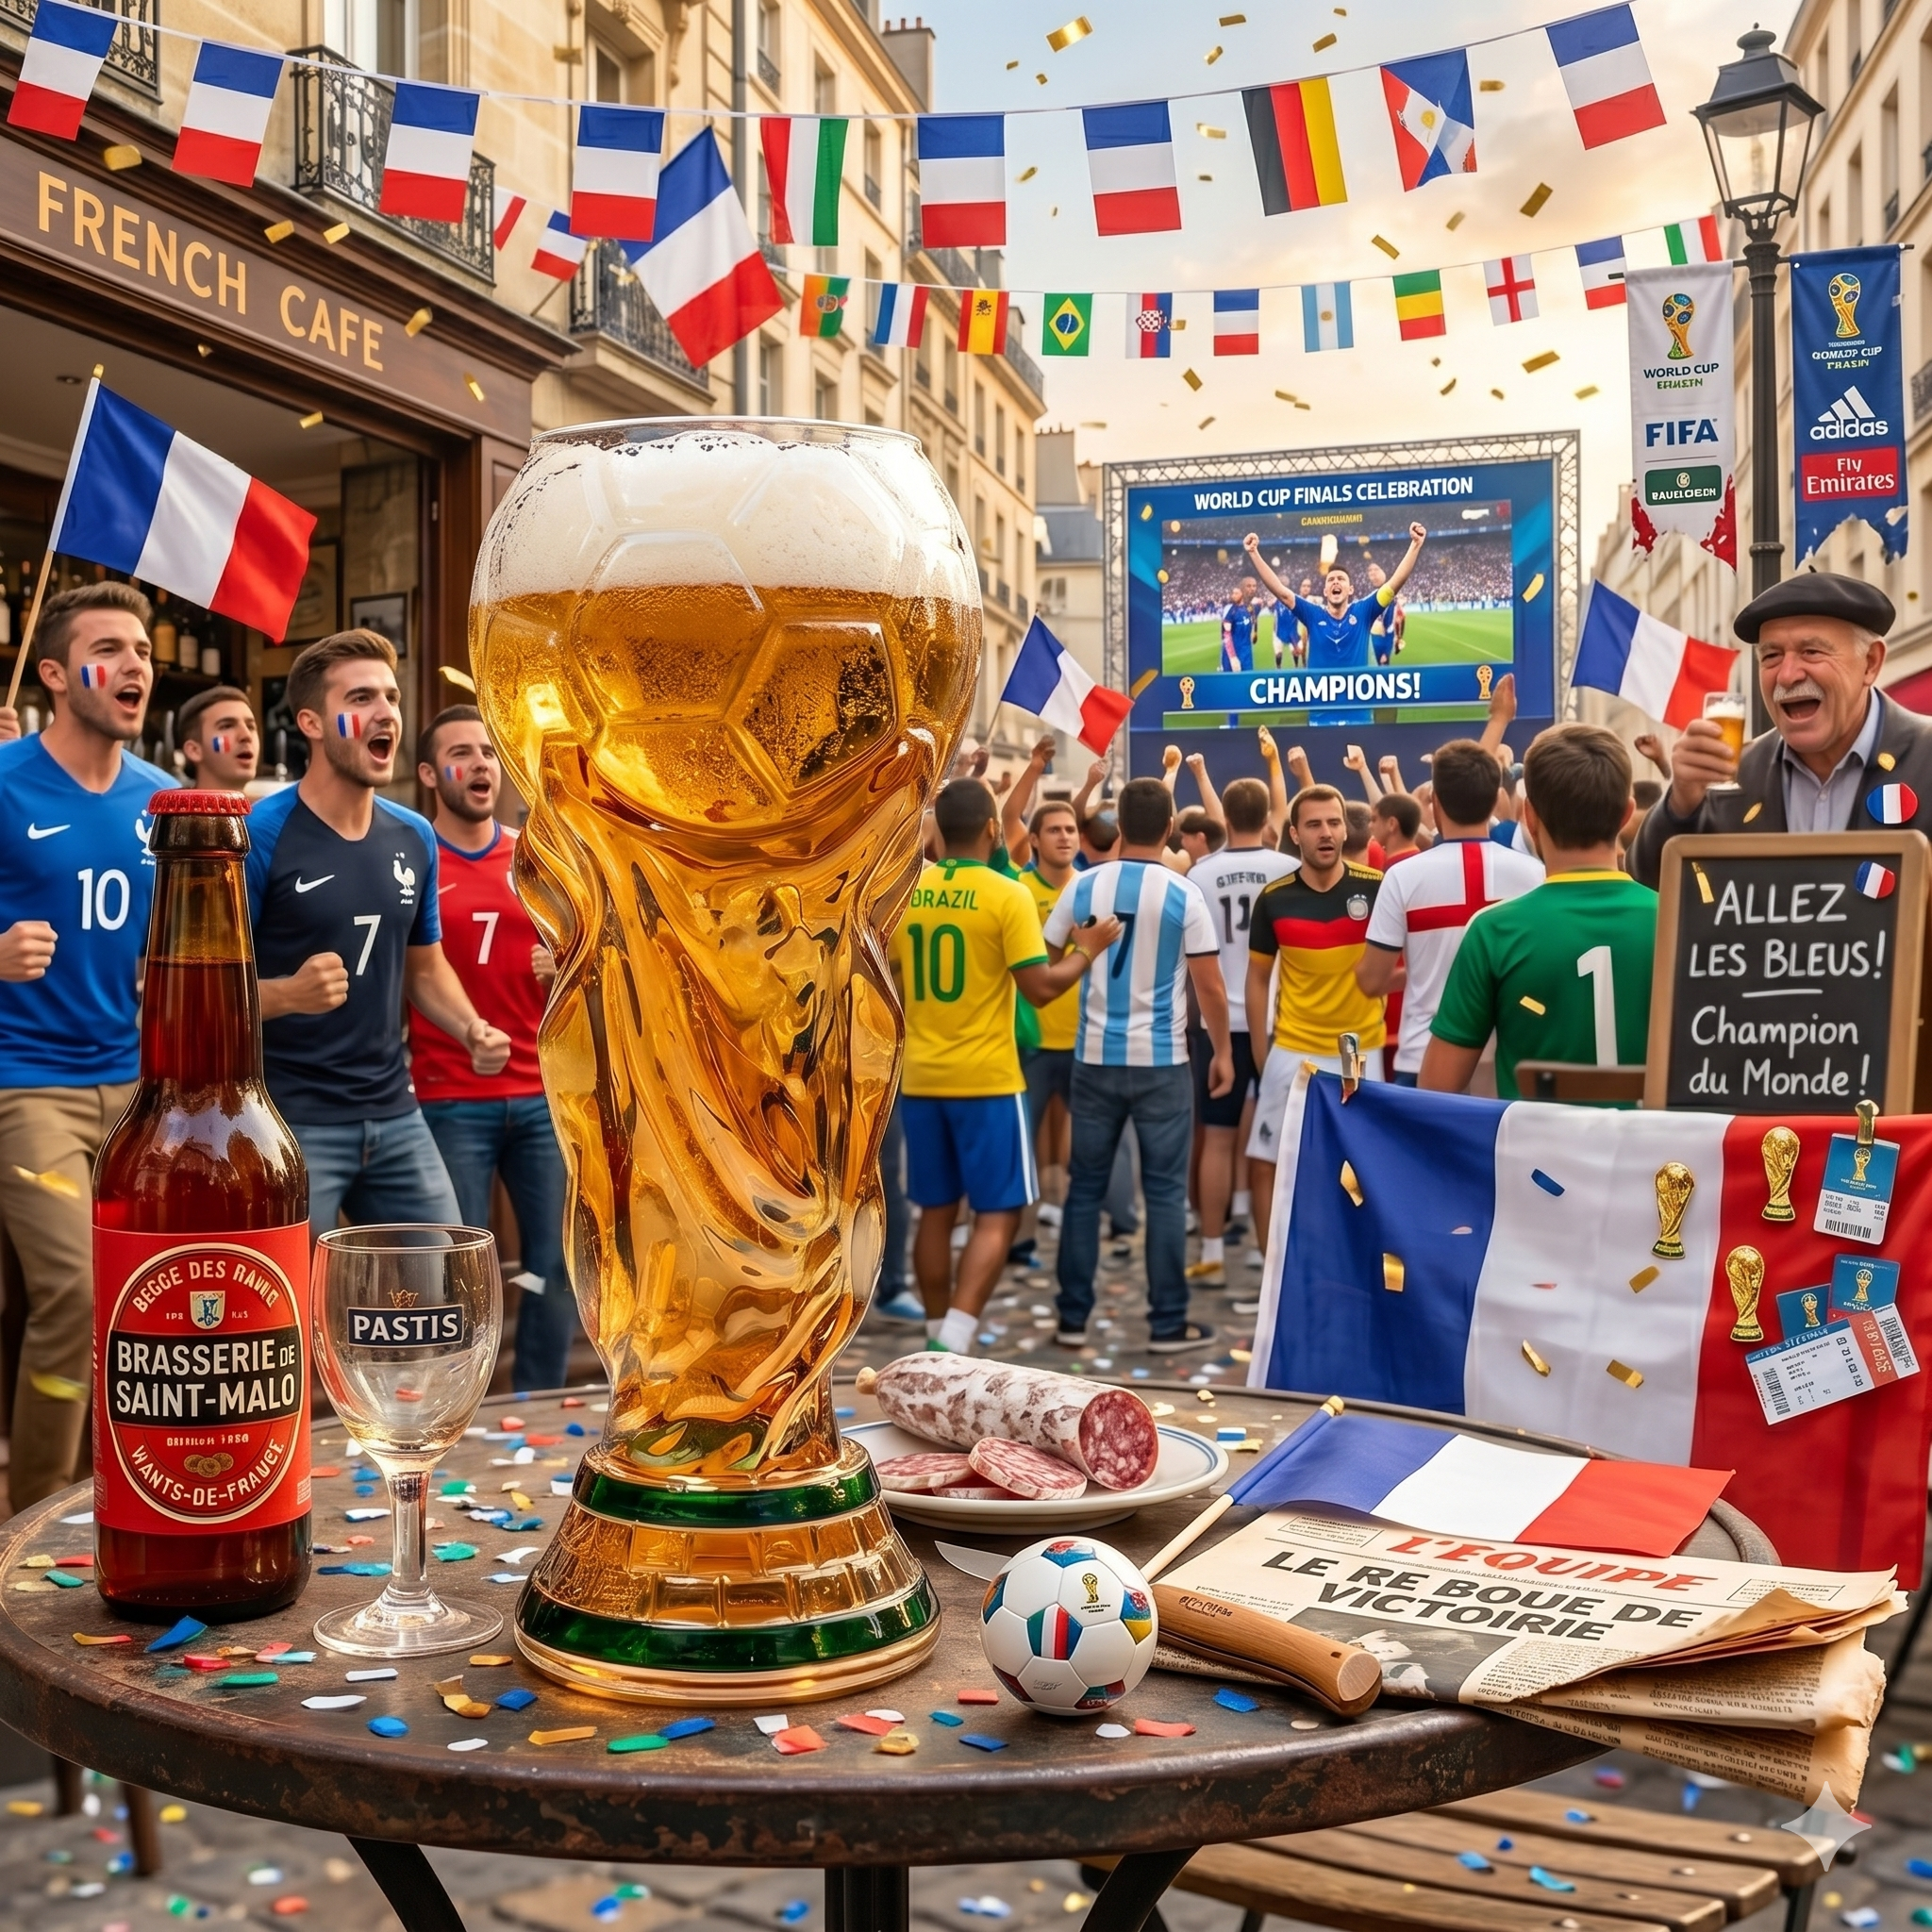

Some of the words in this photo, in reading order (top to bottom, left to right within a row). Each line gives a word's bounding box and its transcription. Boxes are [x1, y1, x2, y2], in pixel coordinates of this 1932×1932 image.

[39, 170, 246, 316] FRENCH
[280, 284, 384, 373] CAFE
[1643, 366, 1691, 379] WORLD
[1693, 362, 1720, 375] CUP
[1860, 346, 1883, 358] CUP
[1645, 418, 1719, 448] FIFA
[1809, 418, 1890, 441] adidas
[1807, 473, 1895, 494] Emirates
[1837, 458, 1862, 473] Fly
[1194, 490, 1254, 510] WORLD
[1257, 488, 1291, 507] CUP
[1294, 484, 1353, 505] FINALS
[1356, 475, 1474, 501] CELEBRATION
[1249, 672, 1421, 705] CHAMPIONS!
[77, 868, 130, 932] 10
[1714, 879, 1847, 925] ALLEZ
[353, 914, 381, 976] 7
[472, 911, 498, 965] 7
[1111, 911, 1136, 979] 7
[1689, 942, 1747, 977] LES
[1763, 930, 1886, 979] BLEUS!
[907, 923, 965, 1003] 10
[1576, 945, 1619, 1067] 1
[1690, 1005, 1859, 1059] Champion
[1689, 1057, 1729, 1094] du
[189, 1260, 226, 1280] DES
[353, 1312, 459, 1341] PASTIS
[117, 1339, 275, 1375] BRASSERIE
[279, 1344, 296, 1368] DE
[116, 1373, 296, 1417] SAINT-MALO
[1386, 1535, 1720, 1591] L'EQUIPE
[1261, 1551, 1341, 1577] LE
[1345, 1564, 1429, 1591] RE
[1432, 1579, 1606, 1617] BOUE
[1614, 1603, 1704, 1629] DE
[1317, 1582, 1615, 1641] VICTOIRIE
